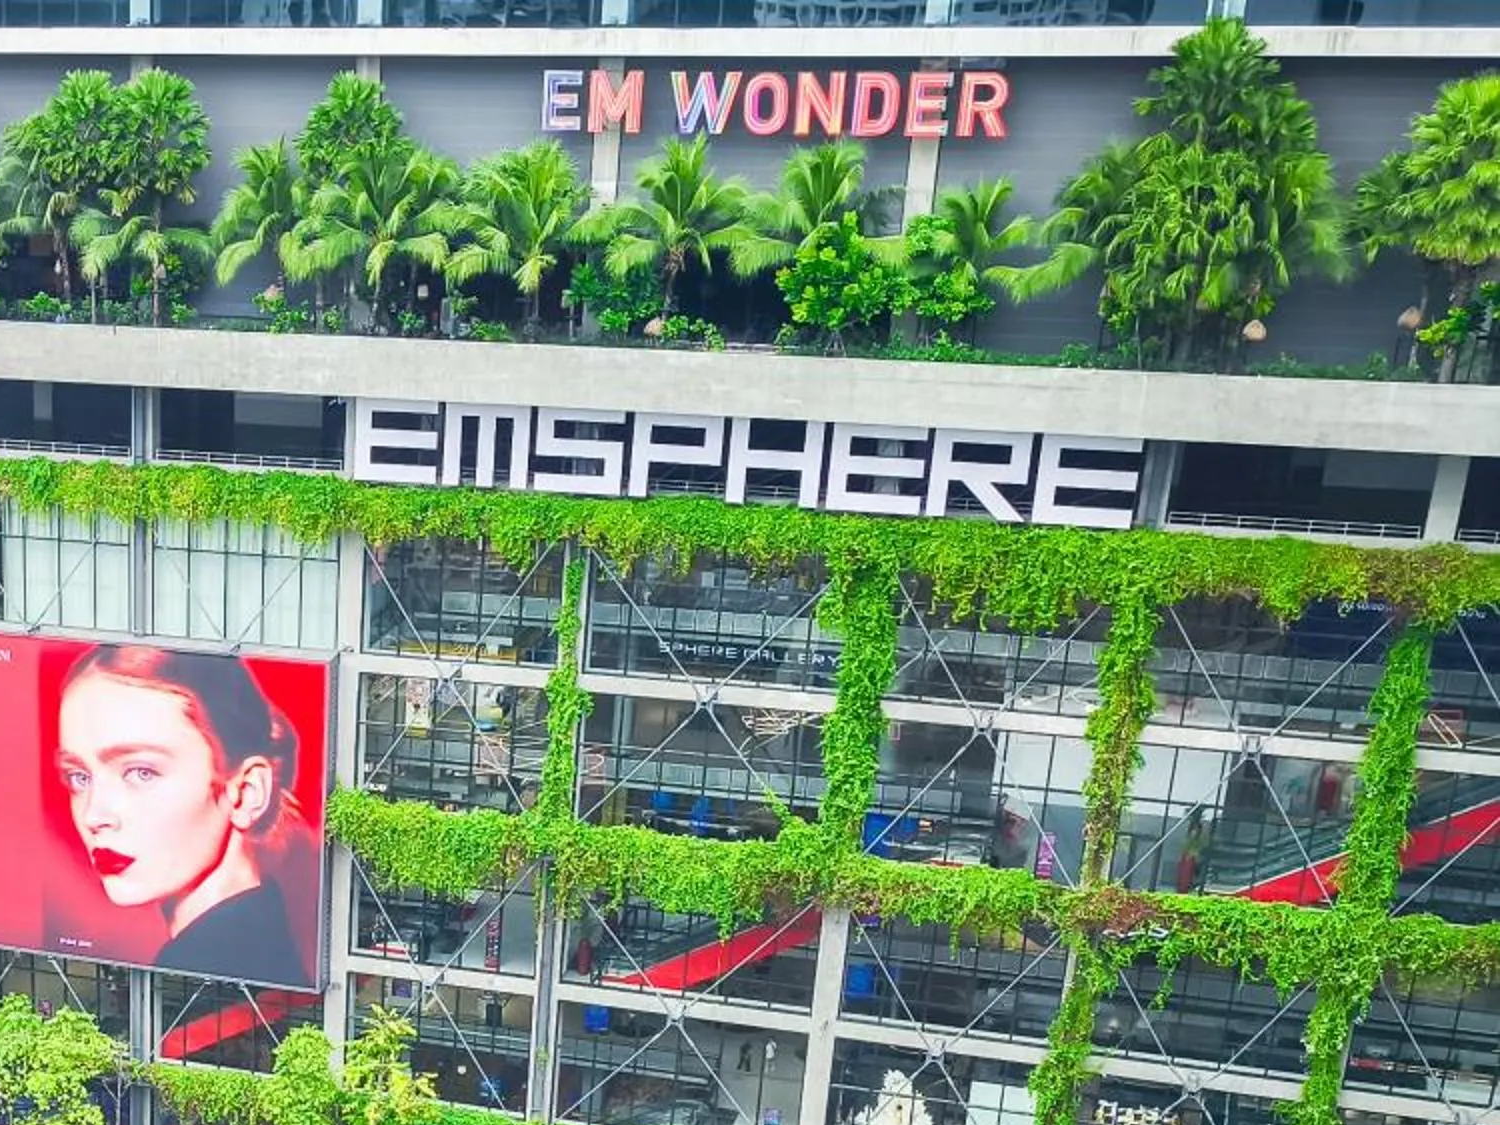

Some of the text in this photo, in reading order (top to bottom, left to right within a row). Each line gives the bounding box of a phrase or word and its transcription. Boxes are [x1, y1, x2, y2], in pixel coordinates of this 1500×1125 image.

[542, 69, 1011, 138] EM WONDER
[353, 397, 1147, 530] EMSPHERE
[658, 641, 738, 660] SPHERE
